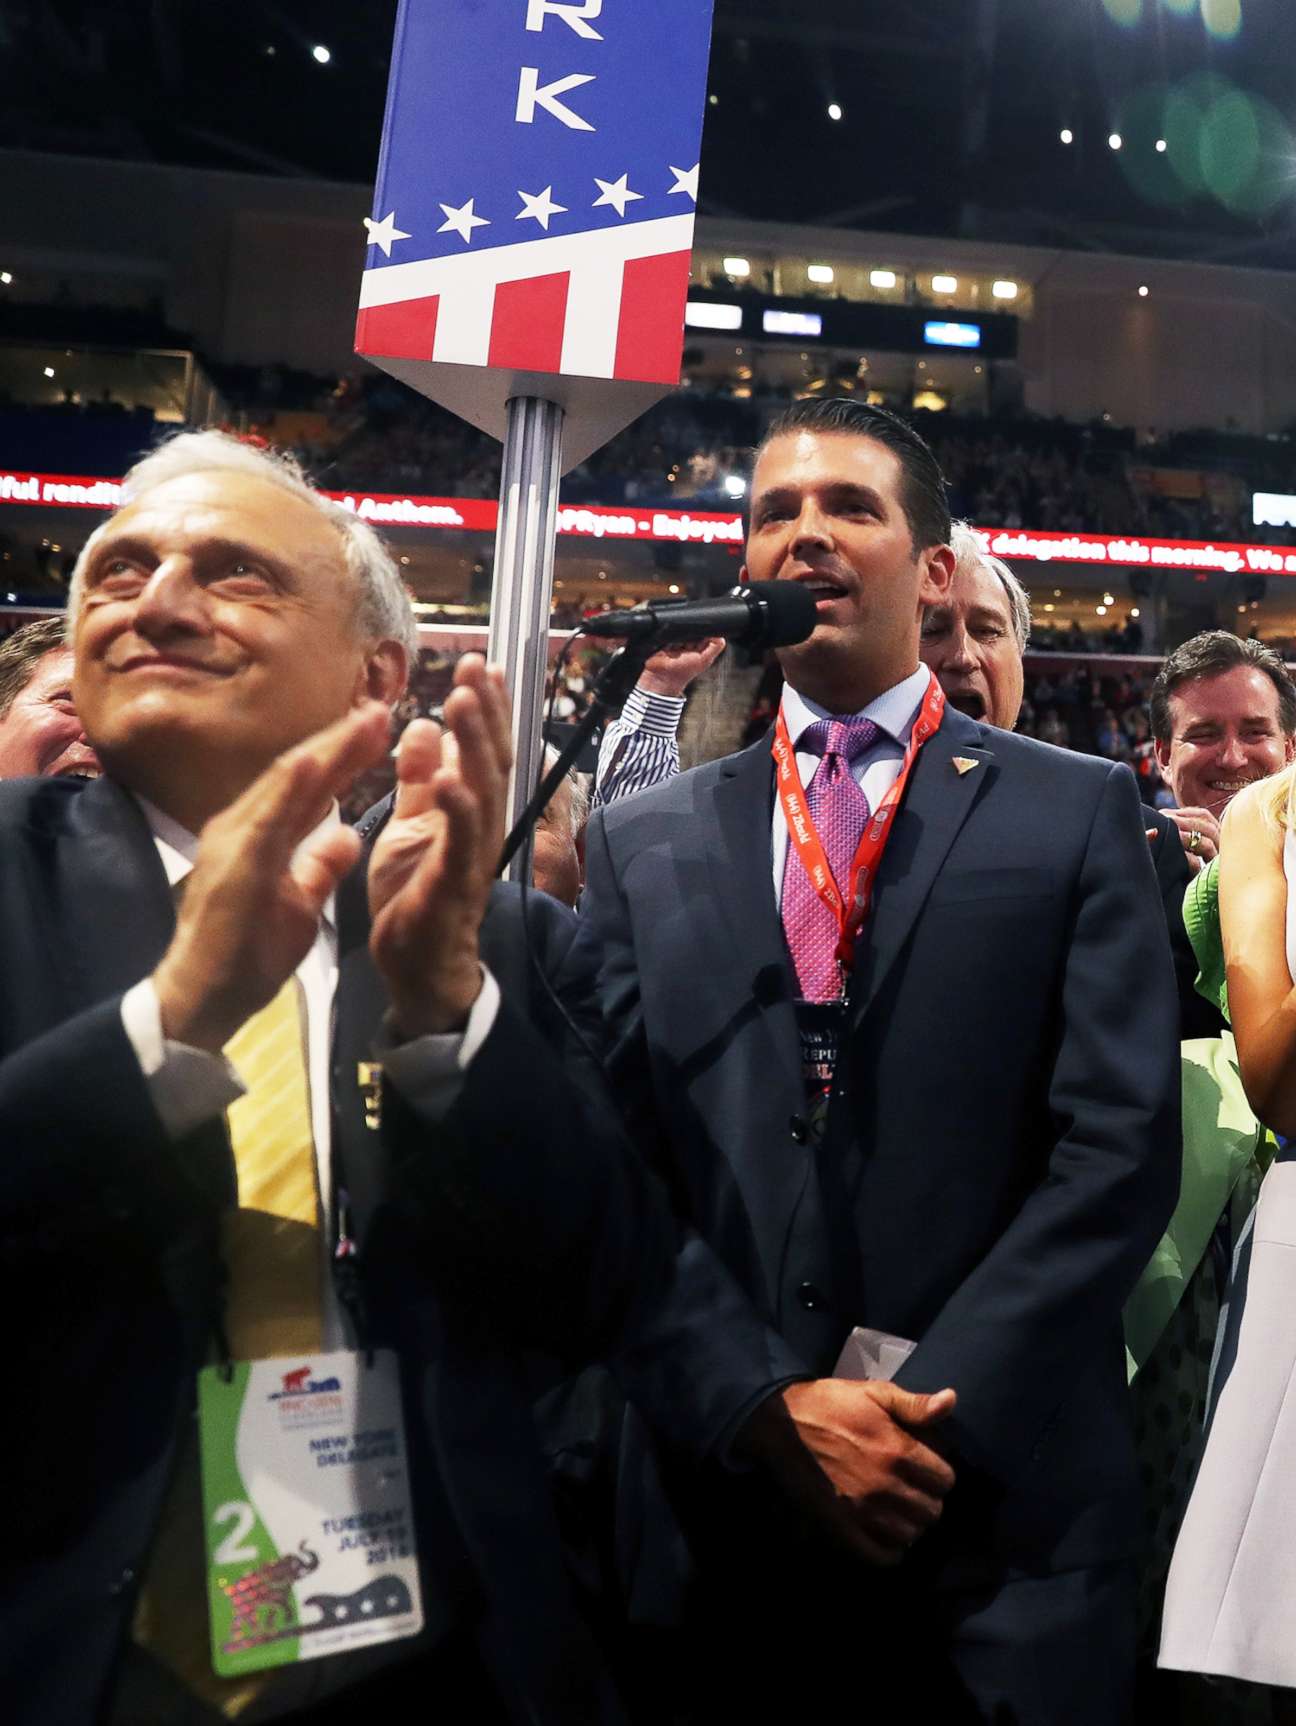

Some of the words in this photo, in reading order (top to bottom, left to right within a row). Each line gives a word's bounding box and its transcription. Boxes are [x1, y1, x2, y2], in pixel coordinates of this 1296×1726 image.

[0, 476, 38, 500] ful
[992, 533, 1106, 560] delegation
[1108, 540, 1149, 562] this
[1151, 546, 1244, 572] morning.
[1247, 549, 1282, 570] We
[310, 1435, 348, 1453] NEW
[212, 1500, 259, 1565] 2
[321, 1507, 406, 1536] TUESDAY
